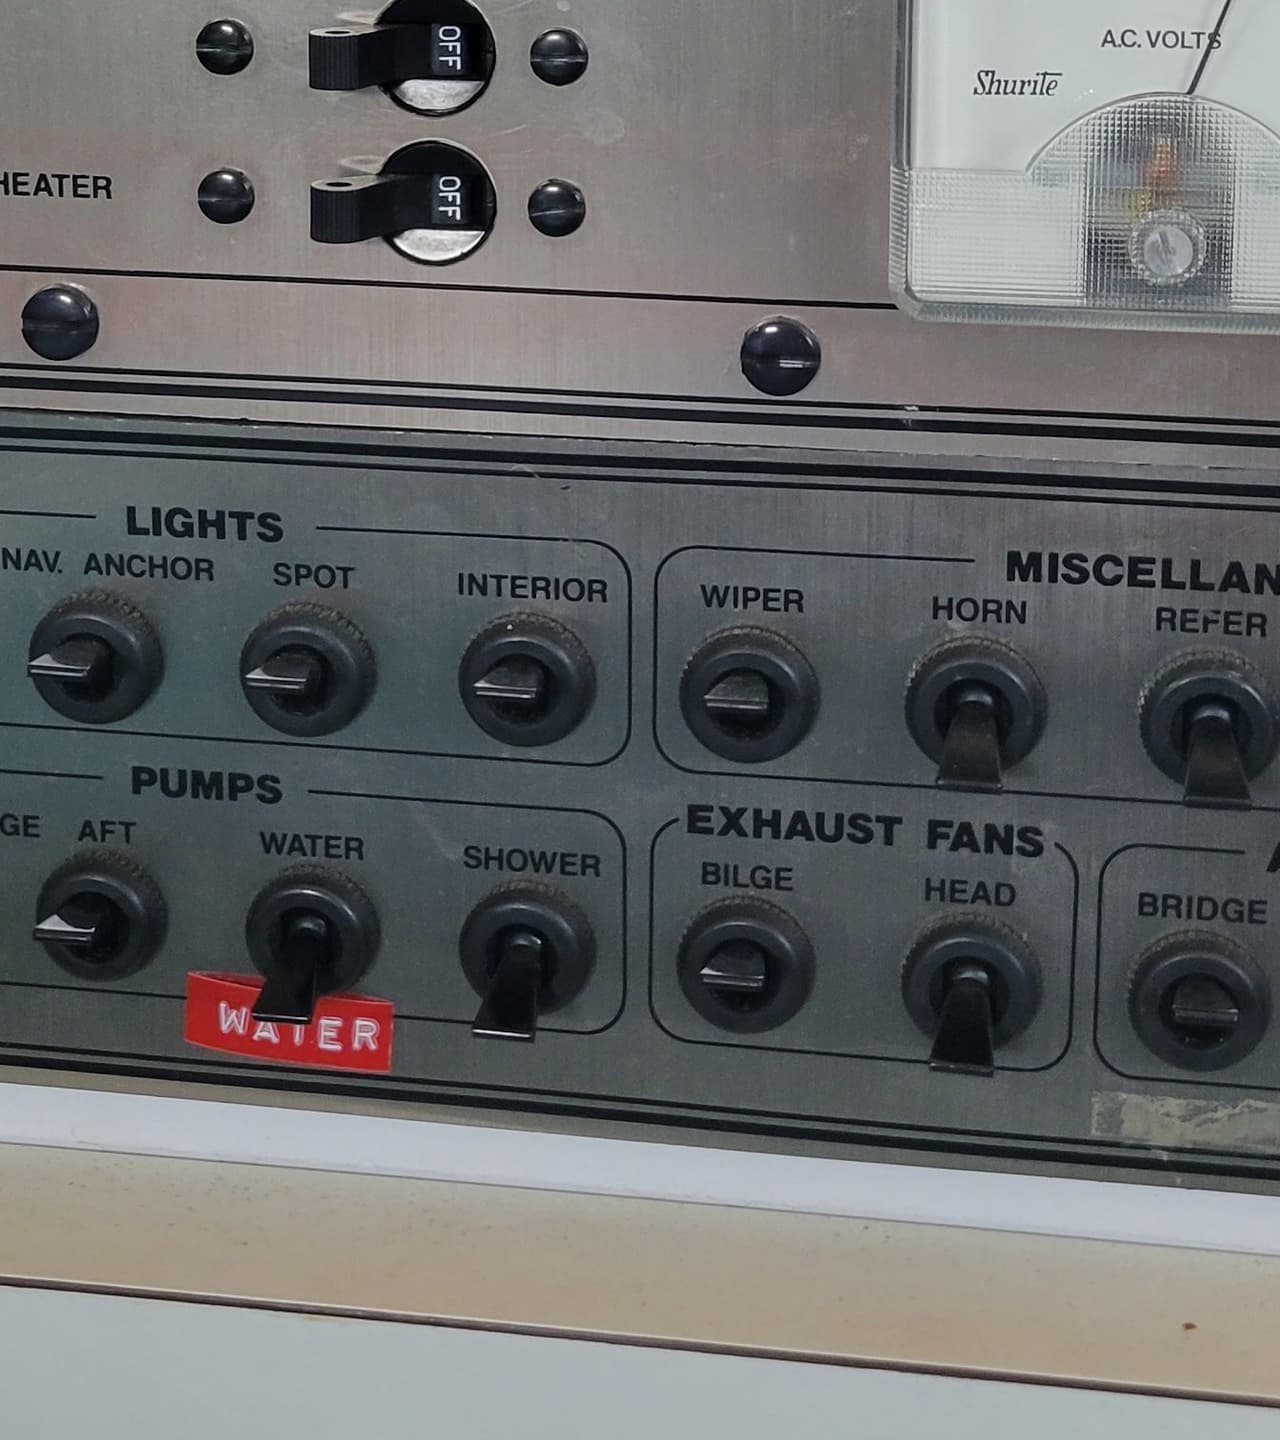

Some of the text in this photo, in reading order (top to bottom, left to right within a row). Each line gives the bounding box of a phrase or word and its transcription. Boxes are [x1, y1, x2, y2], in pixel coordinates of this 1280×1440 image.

[439, 25, 461, 71] OFF
[1101, 29, 1222, 50] A.C. VOLTS
[973, 69, 1063, 97] Shurite
[439, 175, 461, 221] OFF
[126, 506, 284, 543] LIGHTS
[1, 547, 215, 582] NAV. ANCHOR
[272, 563, 355, 590] SPOT
[457, 572, 609, 604] INTERIOR
[700, 583, 805, 614] WIPER
[931, 596, 1027, 625] HORN
[1155, 607, 1268, 638] REFER
[131, 766, 283, 805] PUMPS
[77, 820, 137, 844] AFT
[260, 832, 365, 861] WATER
[686, 804, 1045, 858] EXHAUST FANS
[463, 845, 601, 878] SHOWER
[700, 862, 794, 892] BILGE
[924, 877, 1016, 908] HEAD
[1137, 893, 1268, 925] BRIDGE
